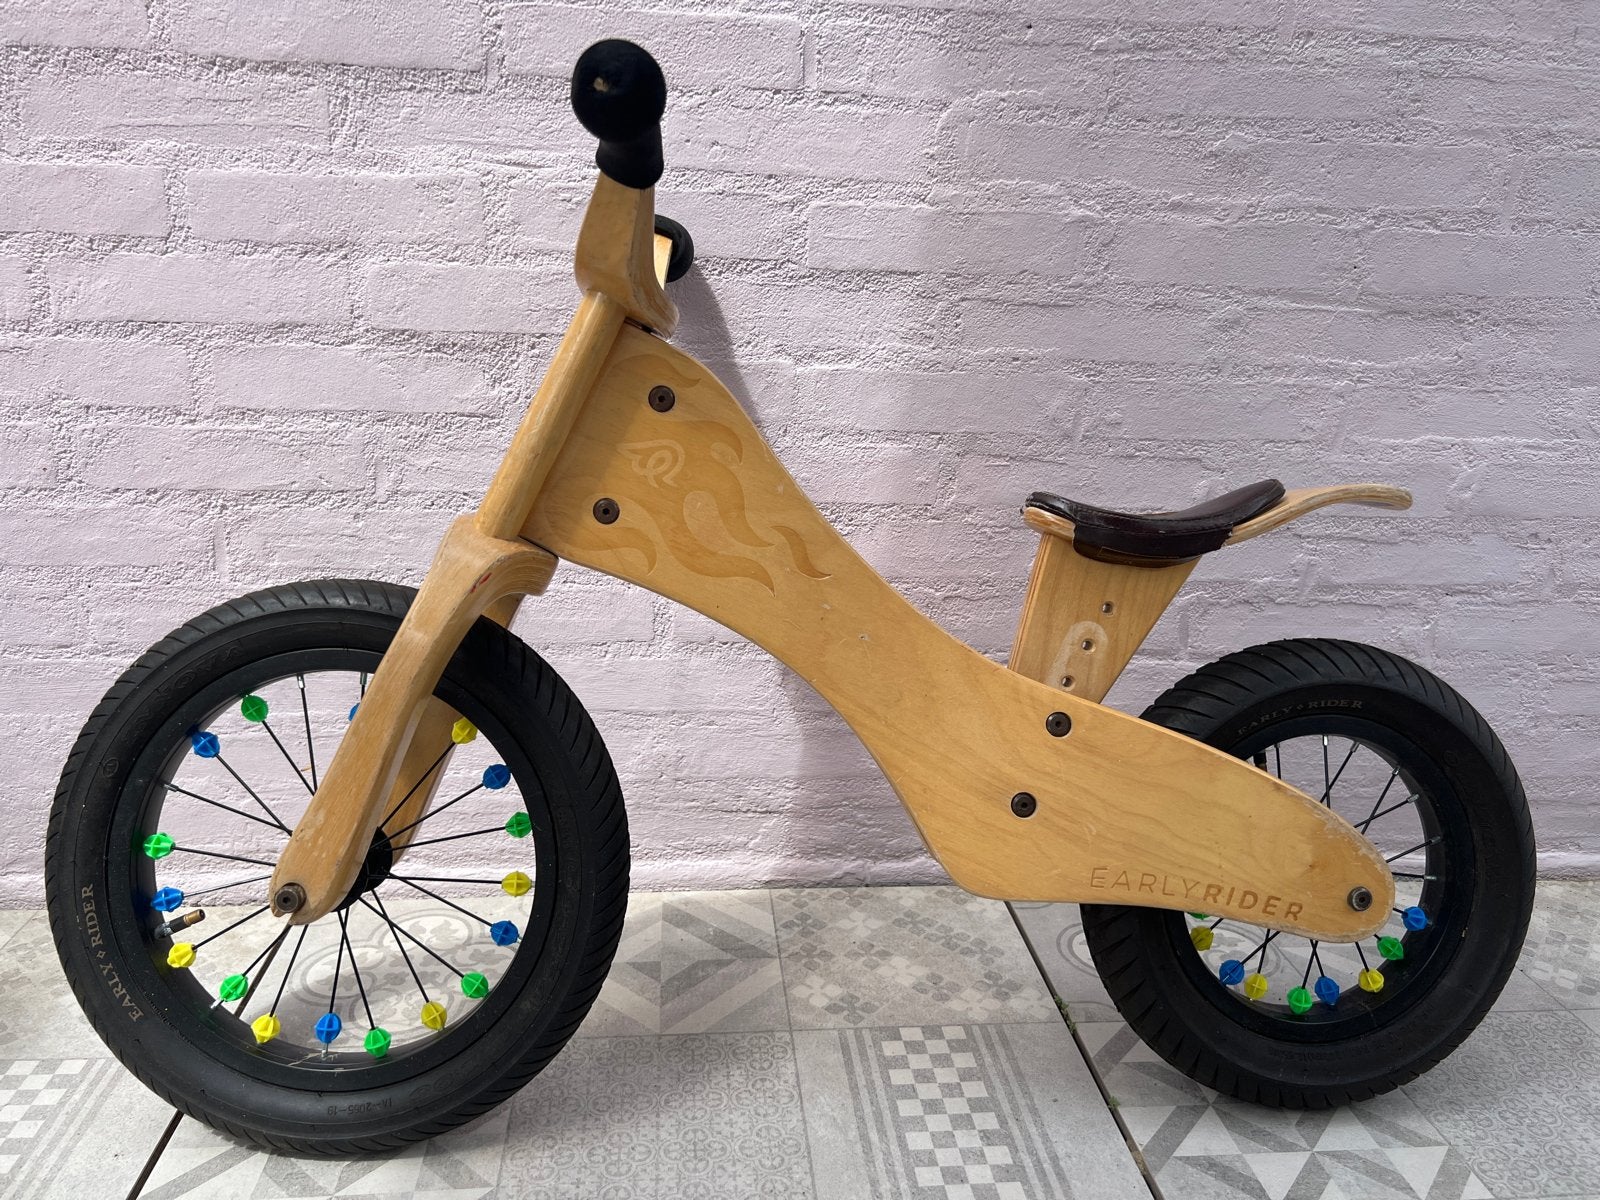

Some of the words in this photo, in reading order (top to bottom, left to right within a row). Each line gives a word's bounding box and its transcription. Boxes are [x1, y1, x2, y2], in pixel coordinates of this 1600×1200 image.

[1238, 706, 1293, 735] EARLY
[1308, 699, 1363, 710] RIDER
[81, 883, 103, 947] RIDER
[100, 962, 144, 1022] EARLY
